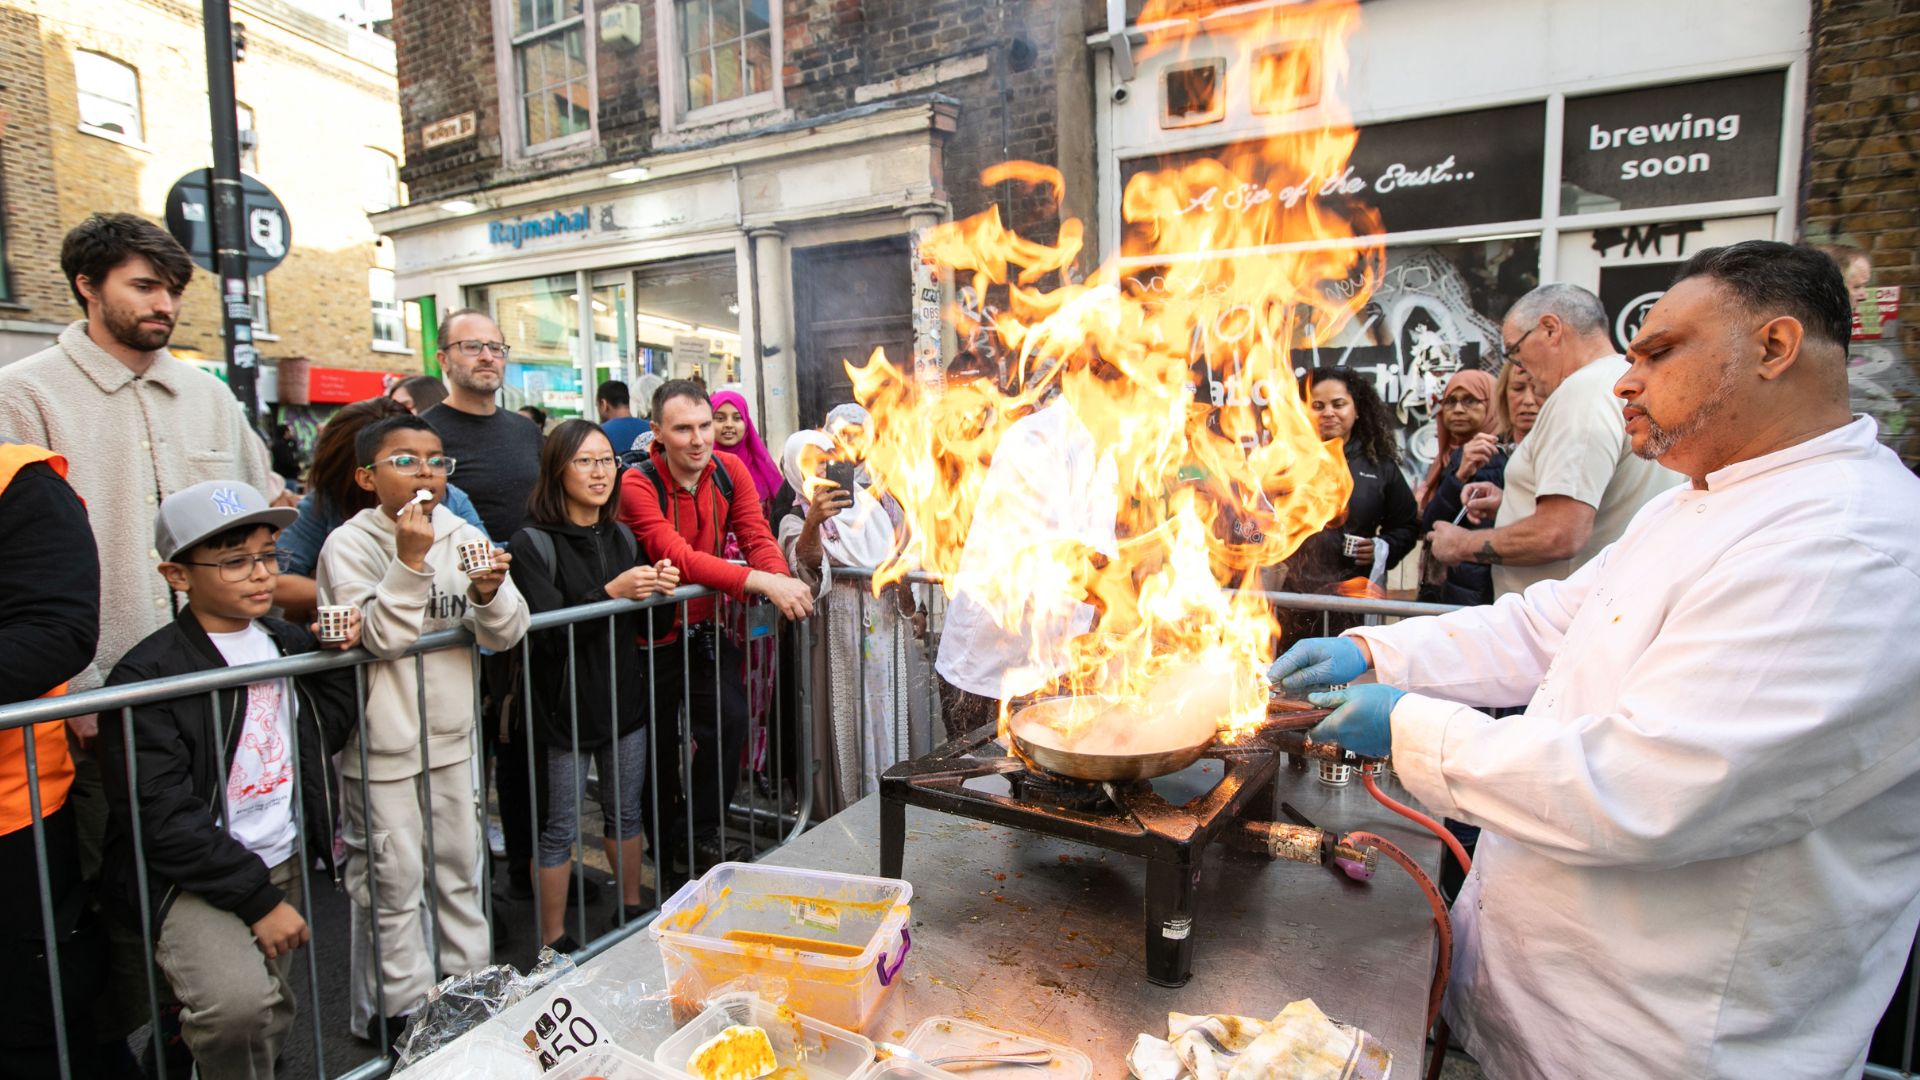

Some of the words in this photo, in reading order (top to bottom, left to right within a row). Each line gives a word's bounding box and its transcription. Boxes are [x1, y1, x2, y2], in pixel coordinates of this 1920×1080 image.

[1589, 113, 1741, 150] brewing
[1620, 152, 1711, 180] soon
[1222, 183, 1272, 212] Sip
[1279, 171, 1316, 209] of
[1319, 165, 1368, 196] the
[488, 204, 591, 249] Rajmahal
